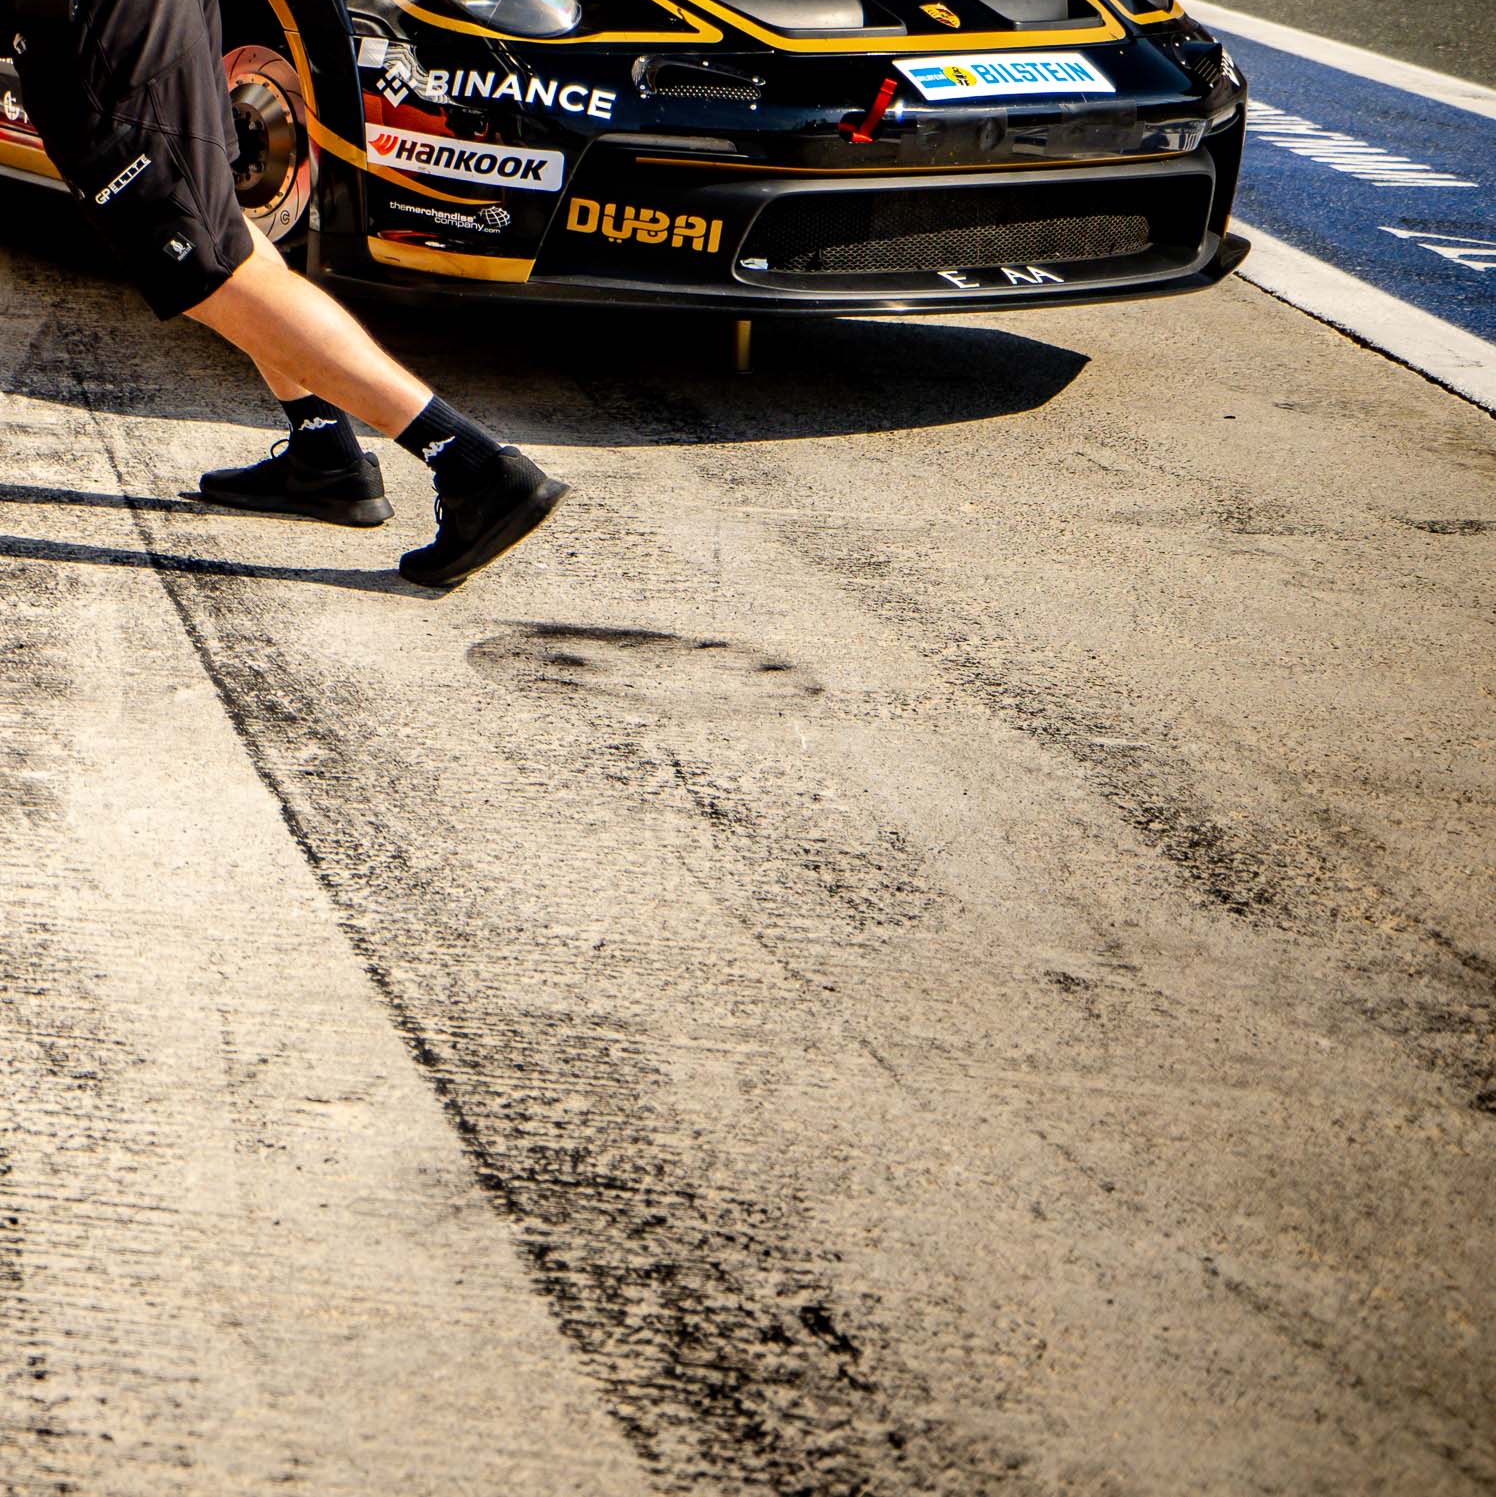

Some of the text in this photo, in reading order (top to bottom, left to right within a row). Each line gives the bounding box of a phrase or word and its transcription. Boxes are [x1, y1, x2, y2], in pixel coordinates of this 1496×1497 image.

[425, 69, 617, 121] BINANCE
[974, 62, 1097, 86] BILSTEIN
[94, 153, 152, 205] GP ELITE
[394, 138, 549, 183] HANKOOK
[565, 196, 725, 254] DUBAI
